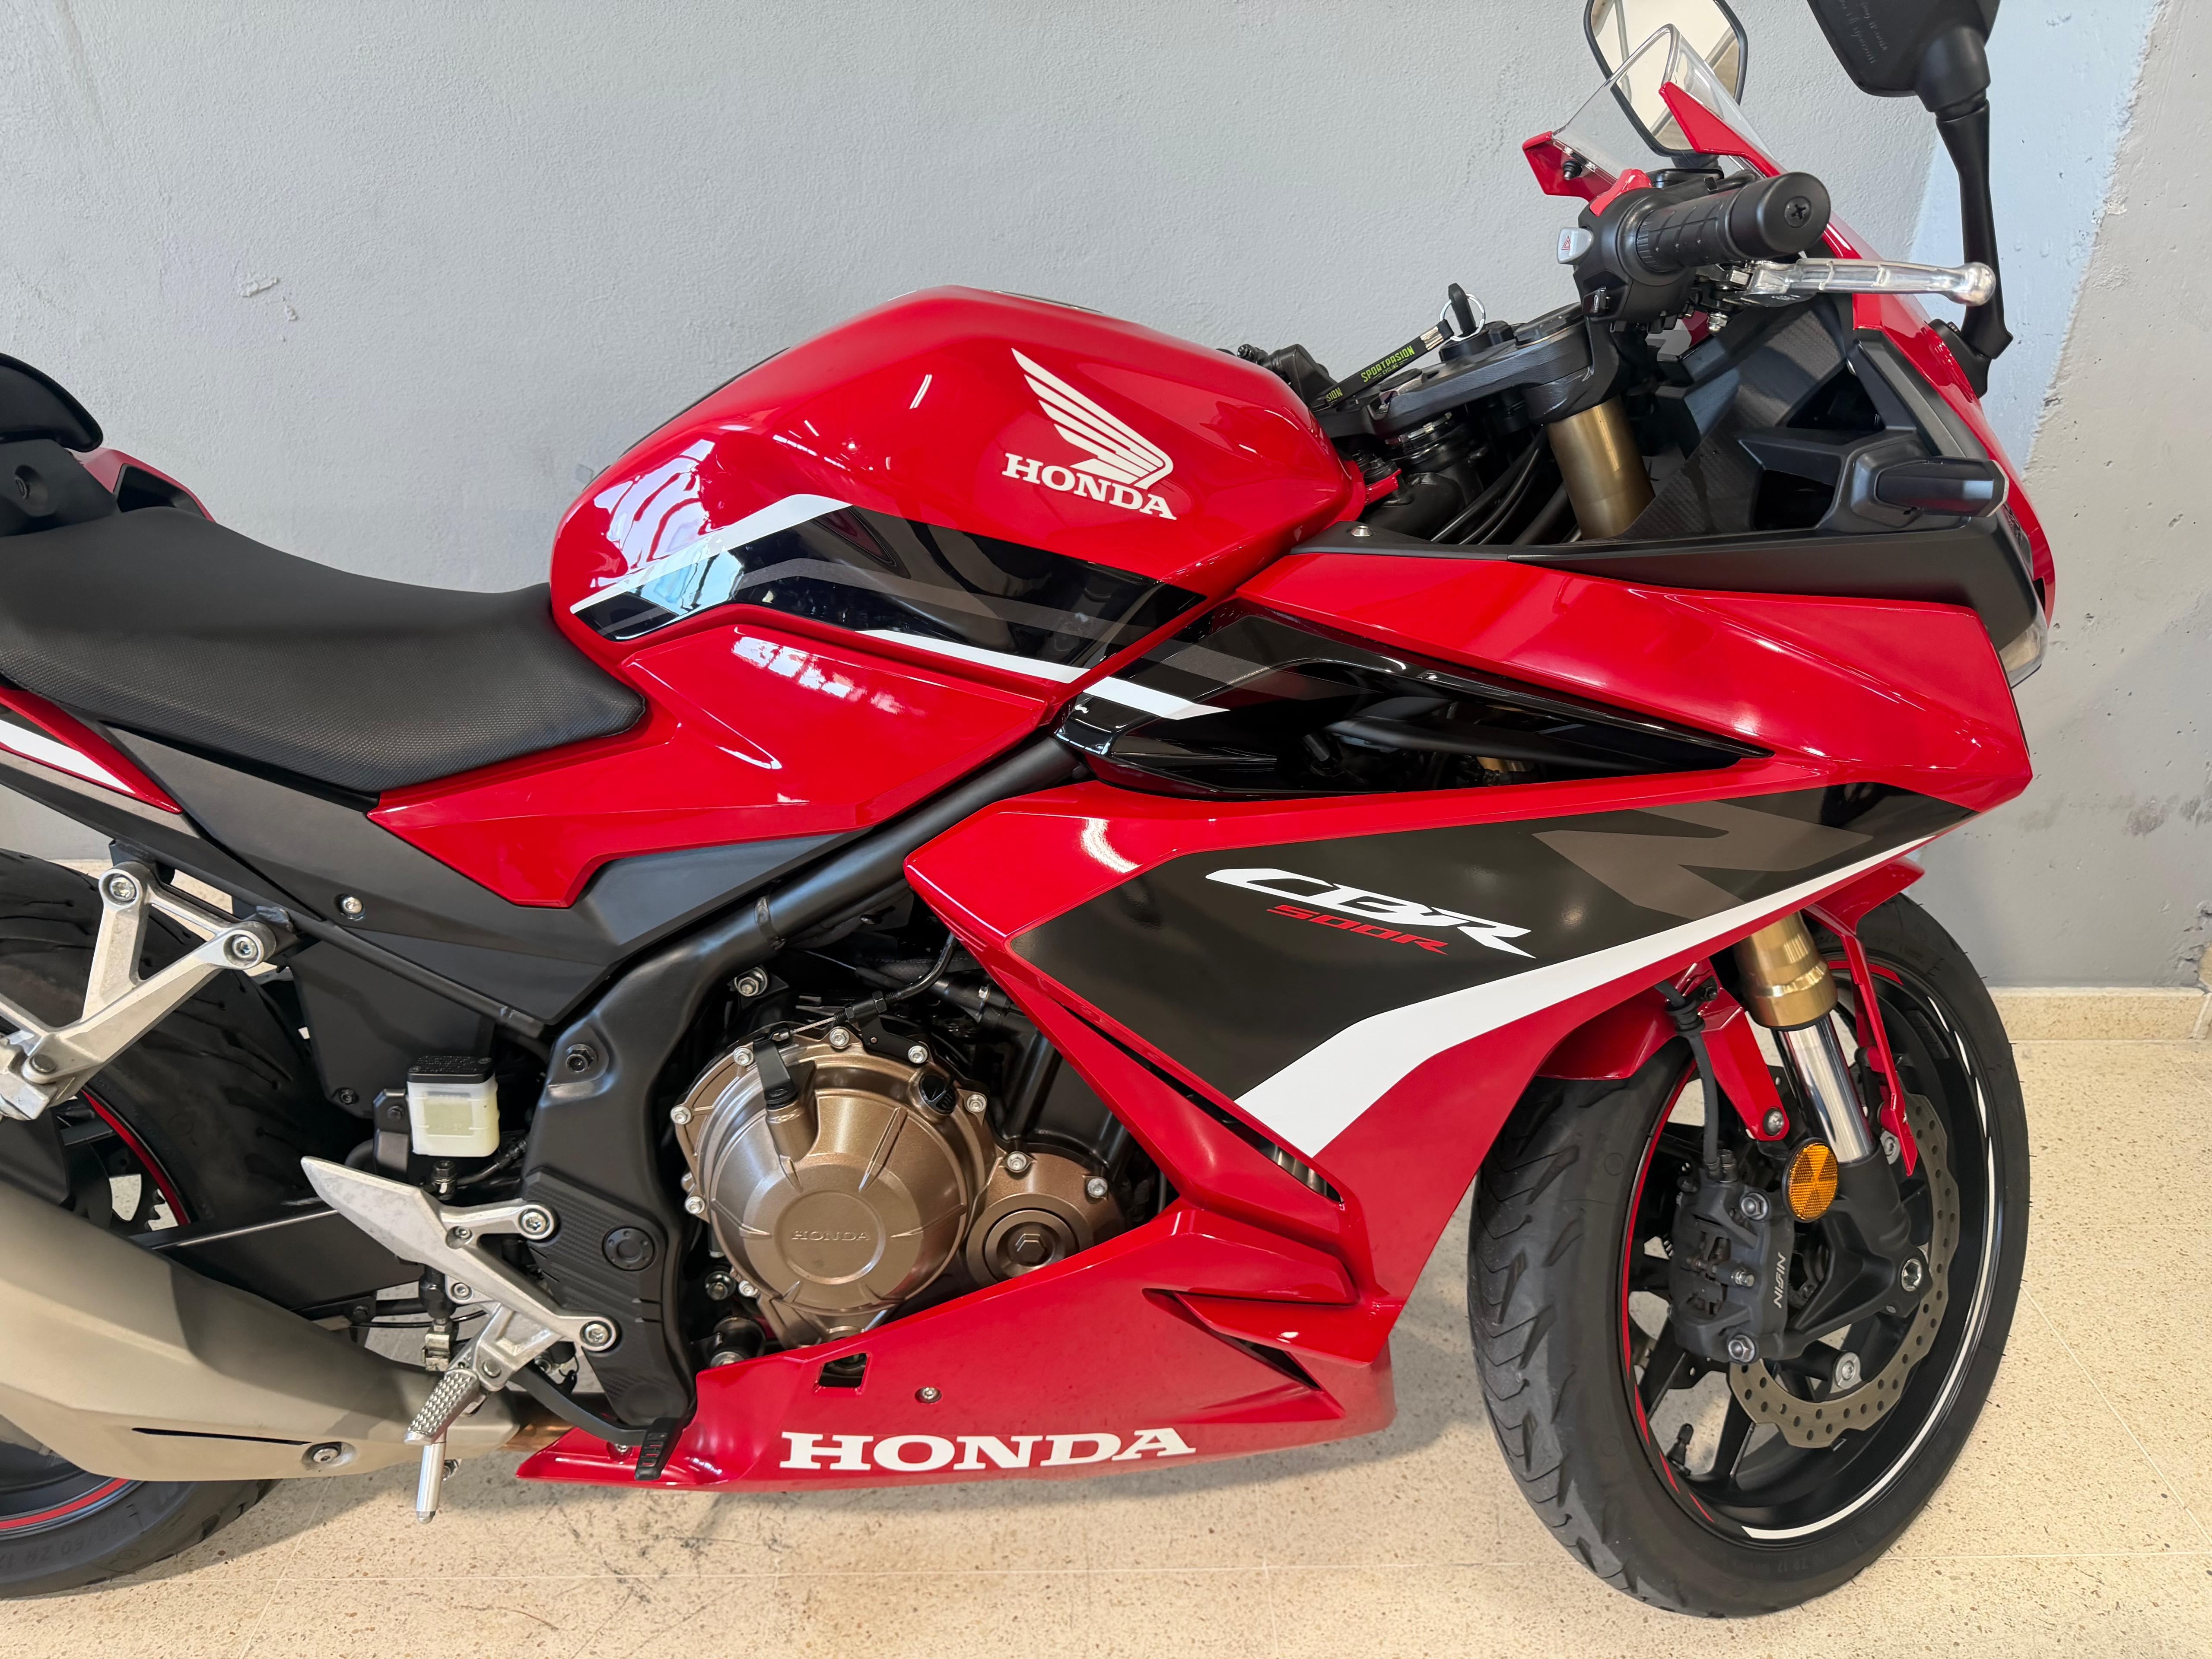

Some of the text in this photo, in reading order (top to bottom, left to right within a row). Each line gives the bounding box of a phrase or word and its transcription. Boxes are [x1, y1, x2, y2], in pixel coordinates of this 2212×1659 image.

[1360, 345, 1415, 383] SPORTPASION
[1002, 453, 1177, 521] HONDA
[1205, 868, 1537, 959] CBR
[1267, 904, 1449, 956] 500R
[791, 1230, 872, 1241] HONDA
[779, 1427, 1196, 1471] HONDA
